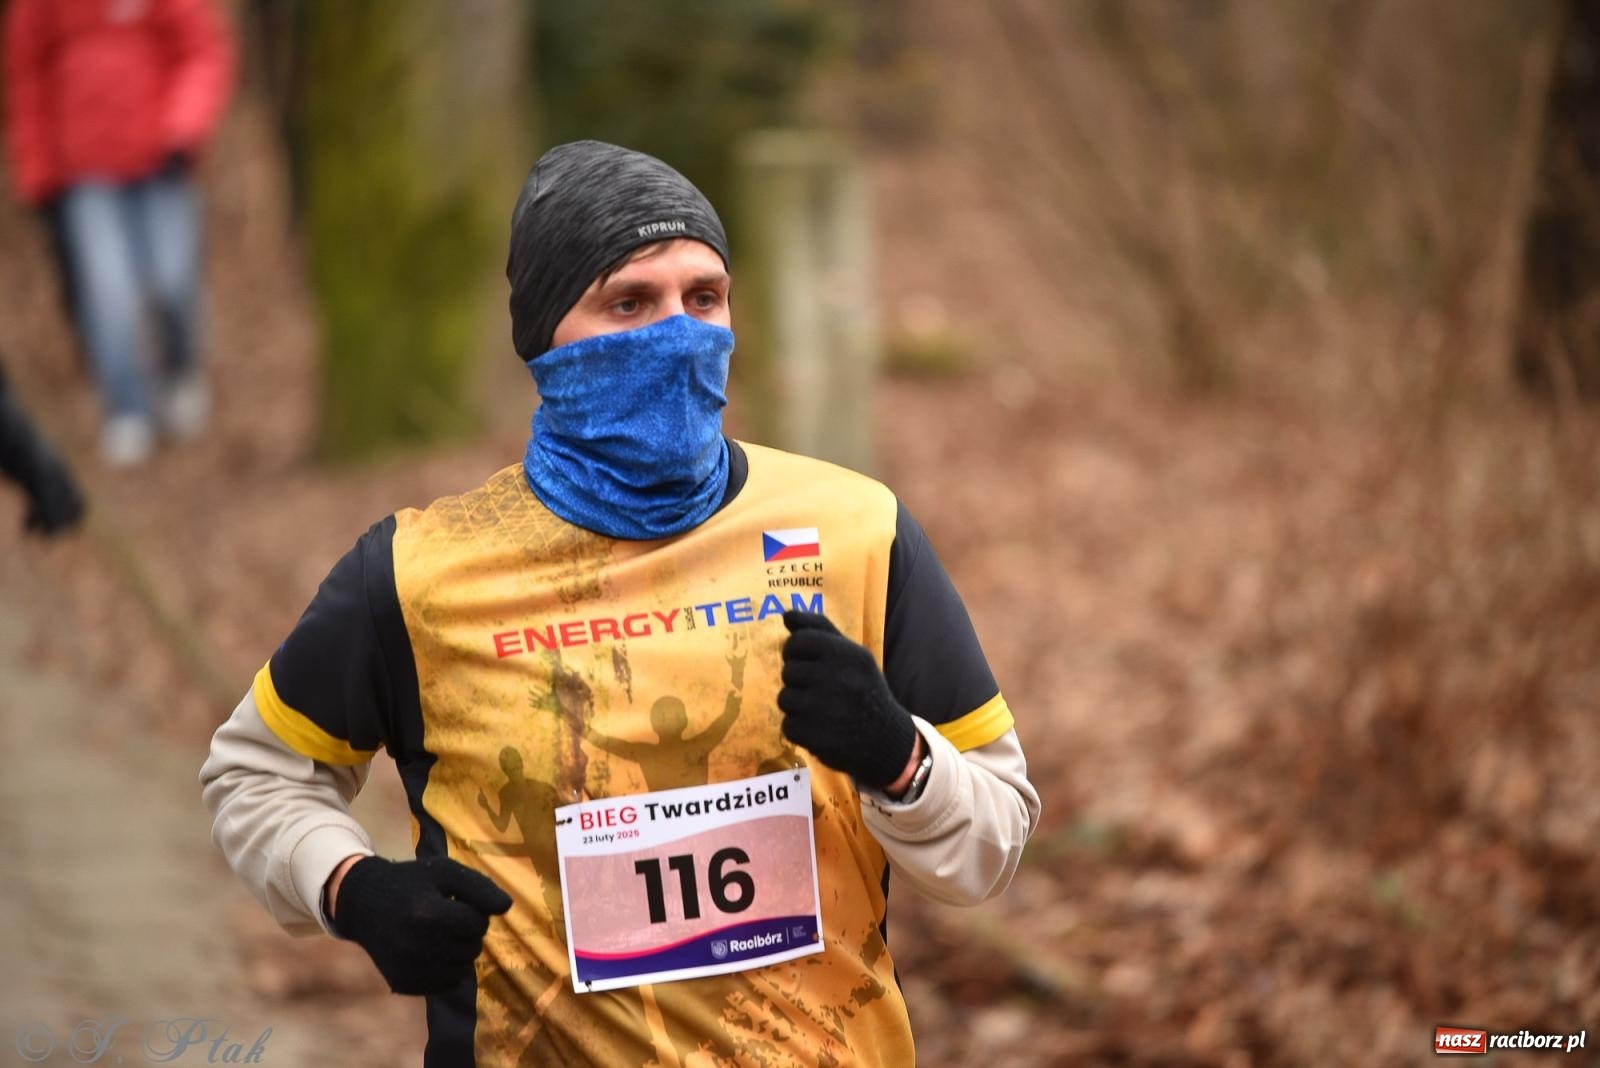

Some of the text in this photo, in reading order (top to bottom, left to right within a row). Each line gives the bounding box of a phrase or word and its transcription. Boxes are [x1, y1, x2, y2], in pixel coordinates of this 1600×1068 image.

[638, 221, 687, 237] KIPRUN
[766, 562, 823, 575] CZECH
[768, 577, 824, 588] REPUBLIC
[493, 608, 680, 658] ENERGY
[695, 593, 824, 627] TEAM
[580, 784, 789, 830] BIEG Twardziela
[583, 835, 594, 844] 23
[595, 833, 615, 843] luty
[634, 847, 755, 924] 116
[729, 932, 783, 953] Racibórz
